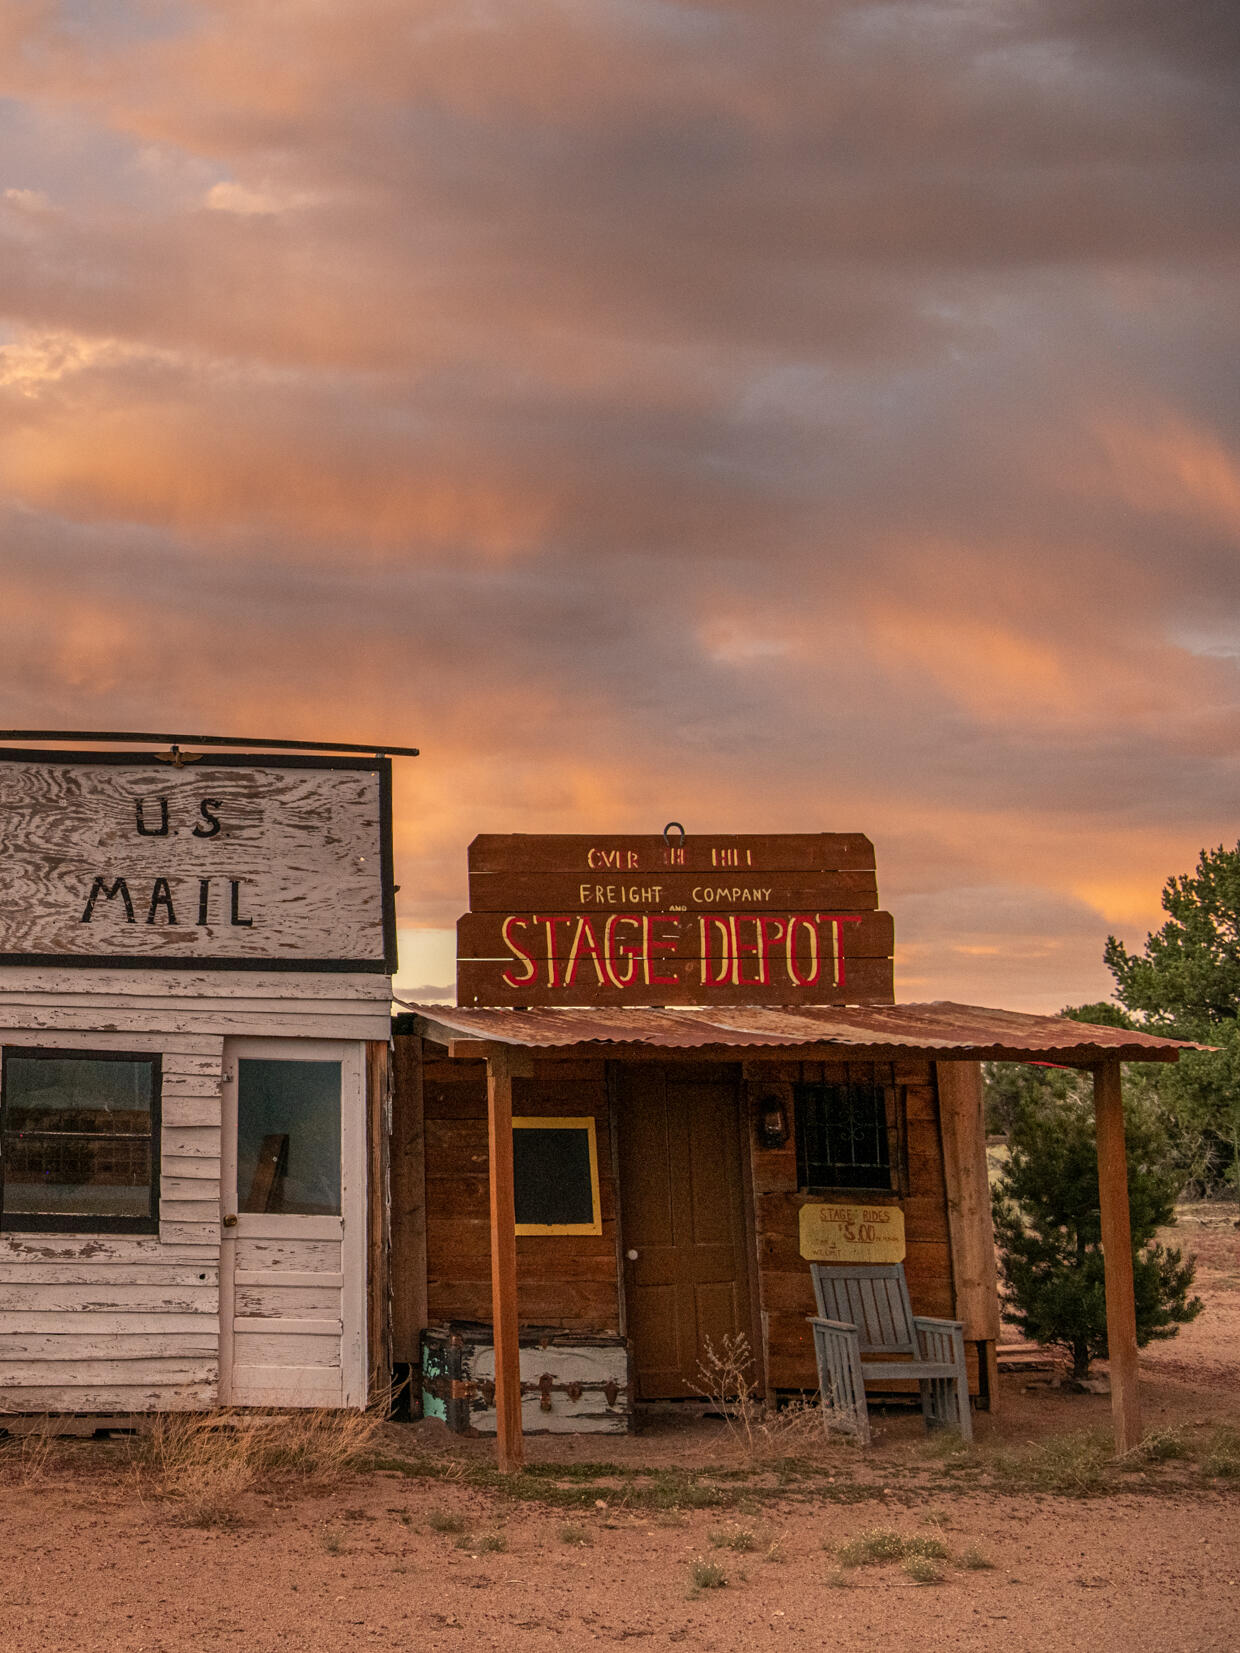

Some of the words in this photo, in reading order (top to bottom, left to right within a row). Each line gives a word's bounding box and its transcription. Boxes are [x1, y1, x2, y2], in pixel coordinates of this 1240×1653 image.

[80, 877, 253, 926] MAIL
[579, 884, 663, 904] FREIGHT
[691, 886, 772, 903] COMPANY
[669, 904, 688, 912] AND
[501, 914, 681, 989] STAGE
[697, 913, 863, 987] DEPOT
[820, 1207, 853, 1222] STAGE
[862, 1208, 891, 1222] RIDES
